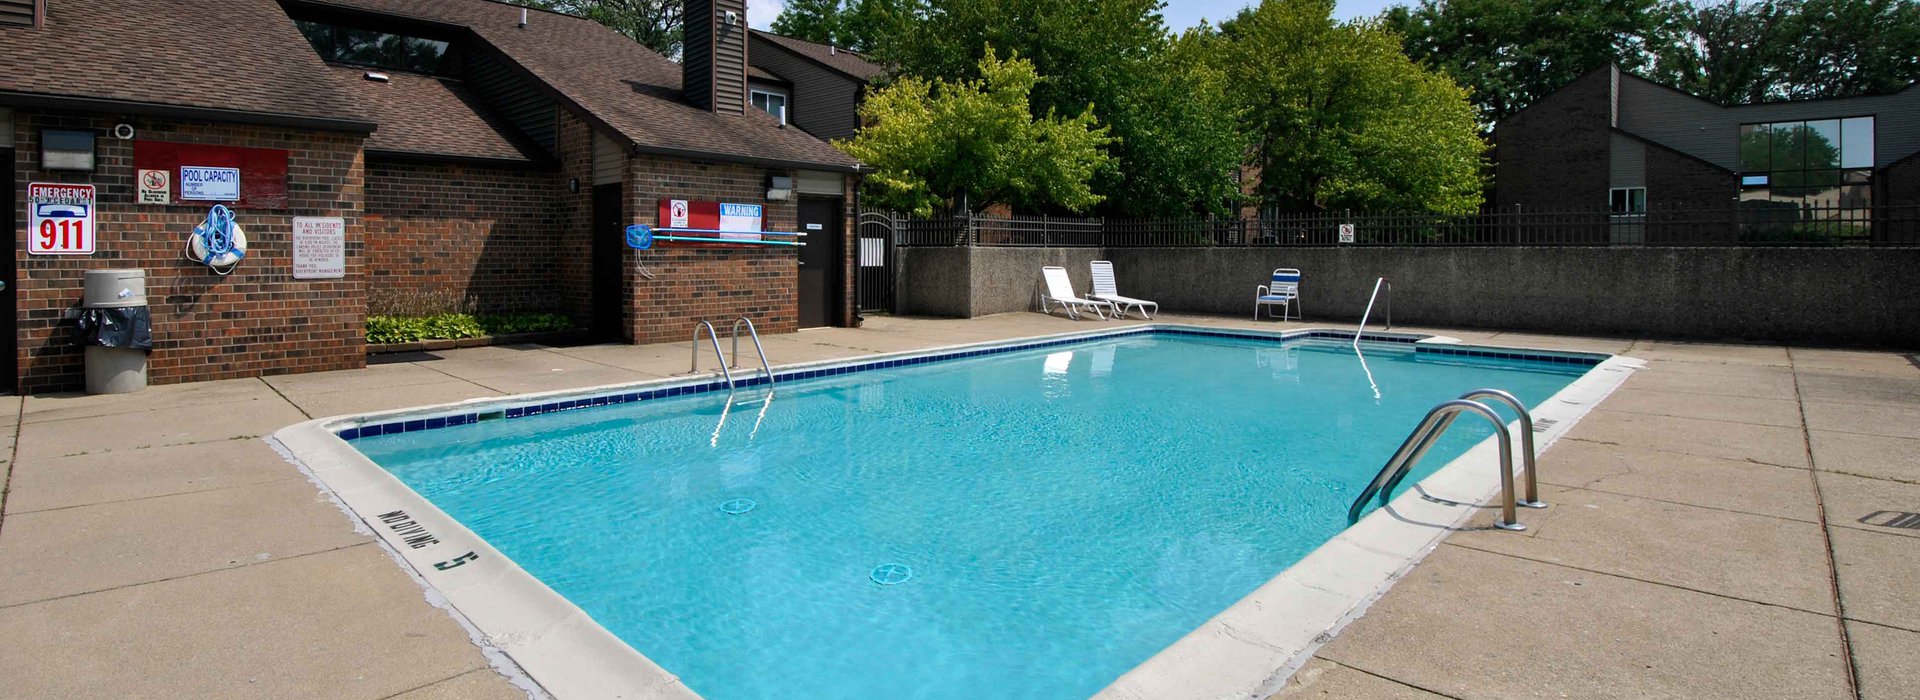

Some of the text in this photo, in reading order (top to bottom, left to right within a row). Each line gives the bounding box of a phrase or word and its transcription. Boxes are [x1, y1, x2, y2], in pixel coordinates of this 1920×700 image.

[184, 169, 236, 183] POOL CAPACITY
[33, 187, 92, 198] EMERGENCY
[723, 205, 759, 217] WARNING
[40, 219, 83, 250] 911
[377, 510, 440, 549] NO DIVING
[433, 551, 479, 571] 5
